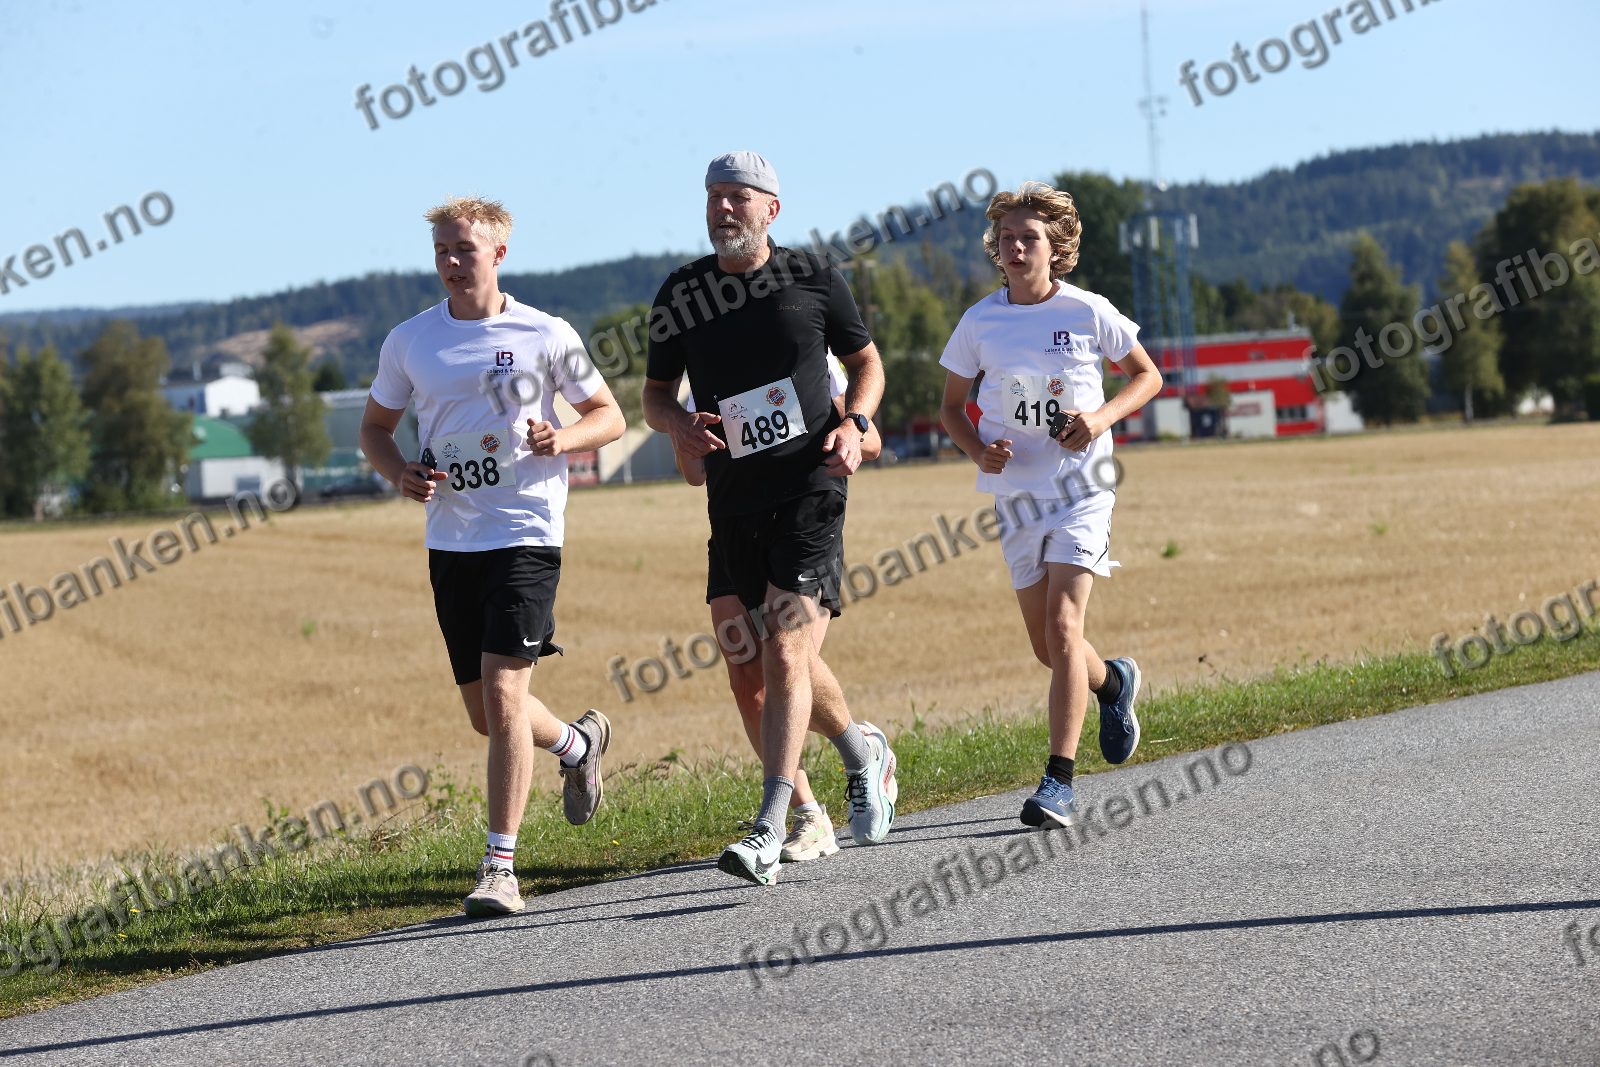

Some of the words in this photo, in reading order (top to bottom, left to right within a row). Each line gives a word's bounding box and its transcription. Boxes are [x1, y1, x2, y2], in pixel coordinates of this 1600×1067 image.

[741, 409, 790, 450] 489
[1014, 399, 1060, 427] 419
[449, 456, 500, 492] 338
